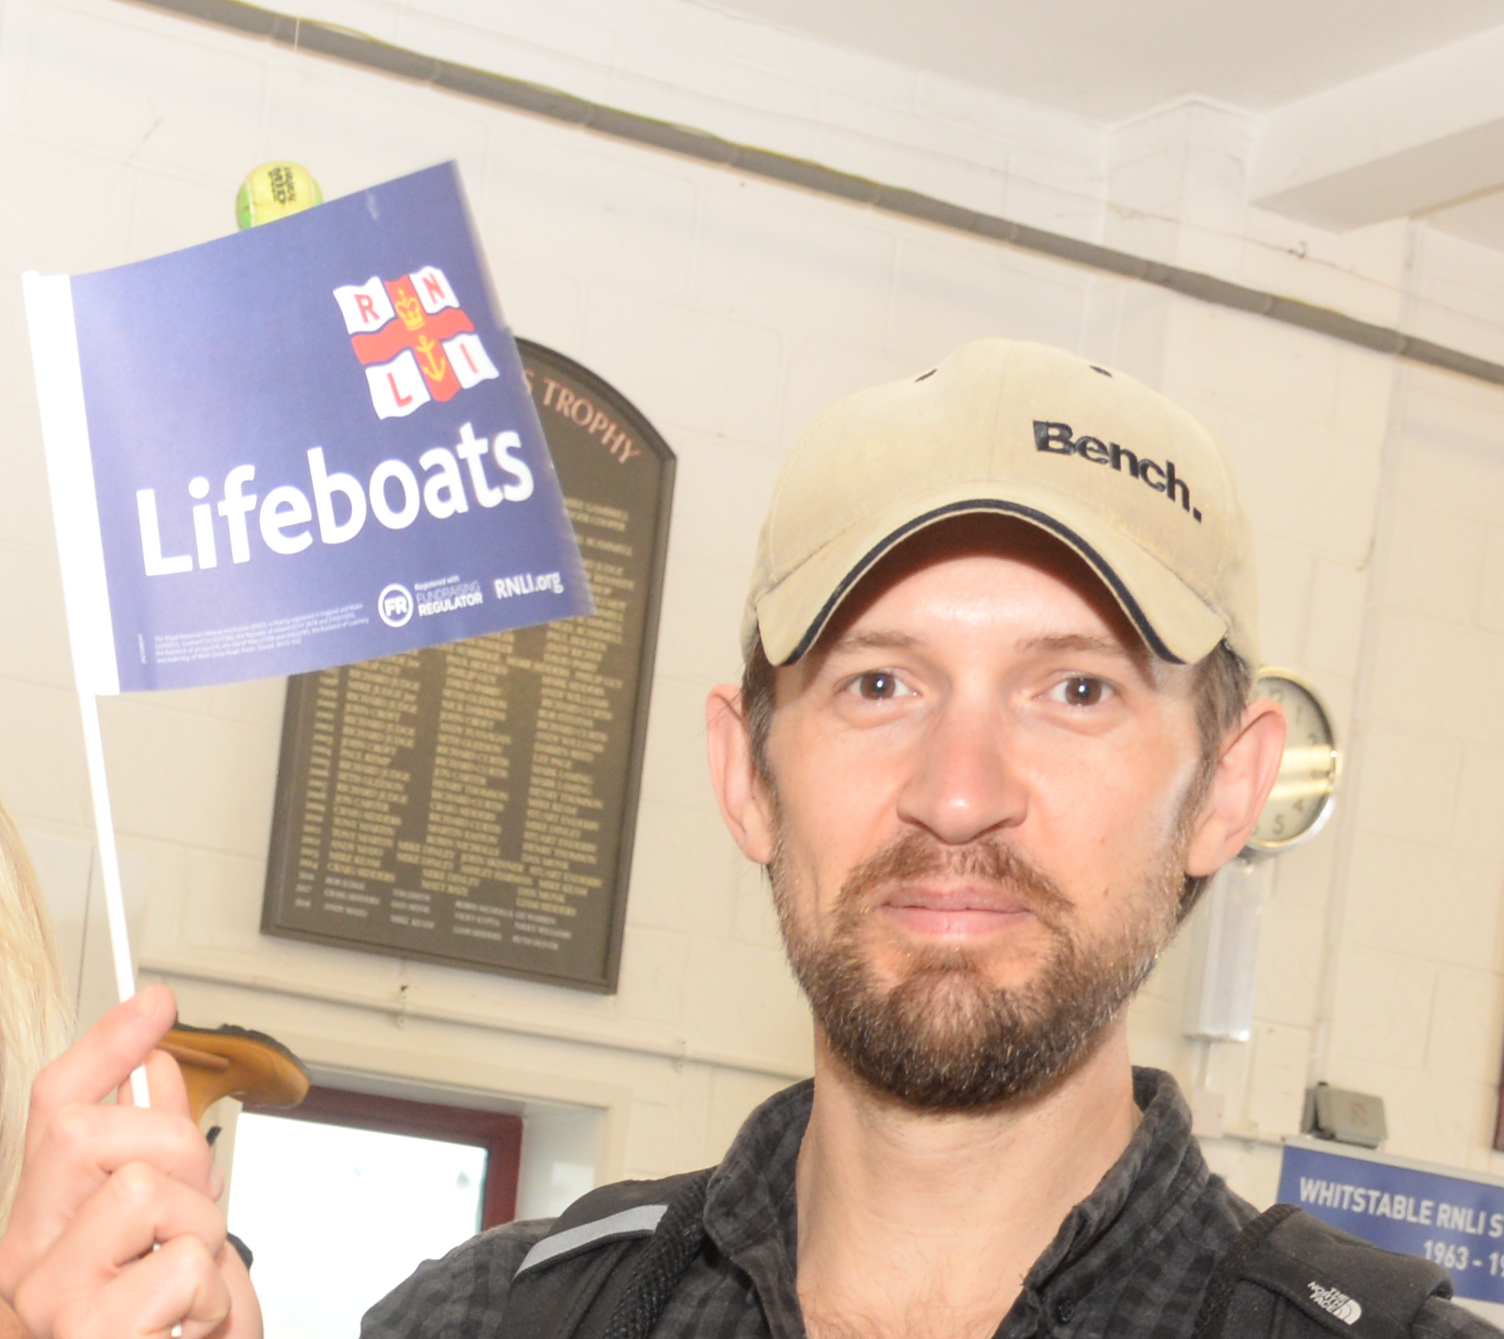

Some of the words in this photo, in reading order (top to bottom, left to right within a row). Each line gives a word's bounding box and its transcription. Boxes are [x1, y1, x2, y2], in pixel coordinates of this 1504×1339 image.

[544, 378, 642, 466] TROPHY
[136, 421, 534, 576] Lifeboats
[1032, 419, 1202, 525] Bench.
[418, 592, 483, 617] REGULATOR
[494, 571, 564, 600] RNLI.org
[1299, 1177, 1431, 1226] WHITSTABLE
[1437, 1208, 1485, 1236] RNLI
[1422, 1241, 1468, 1271] 1963
